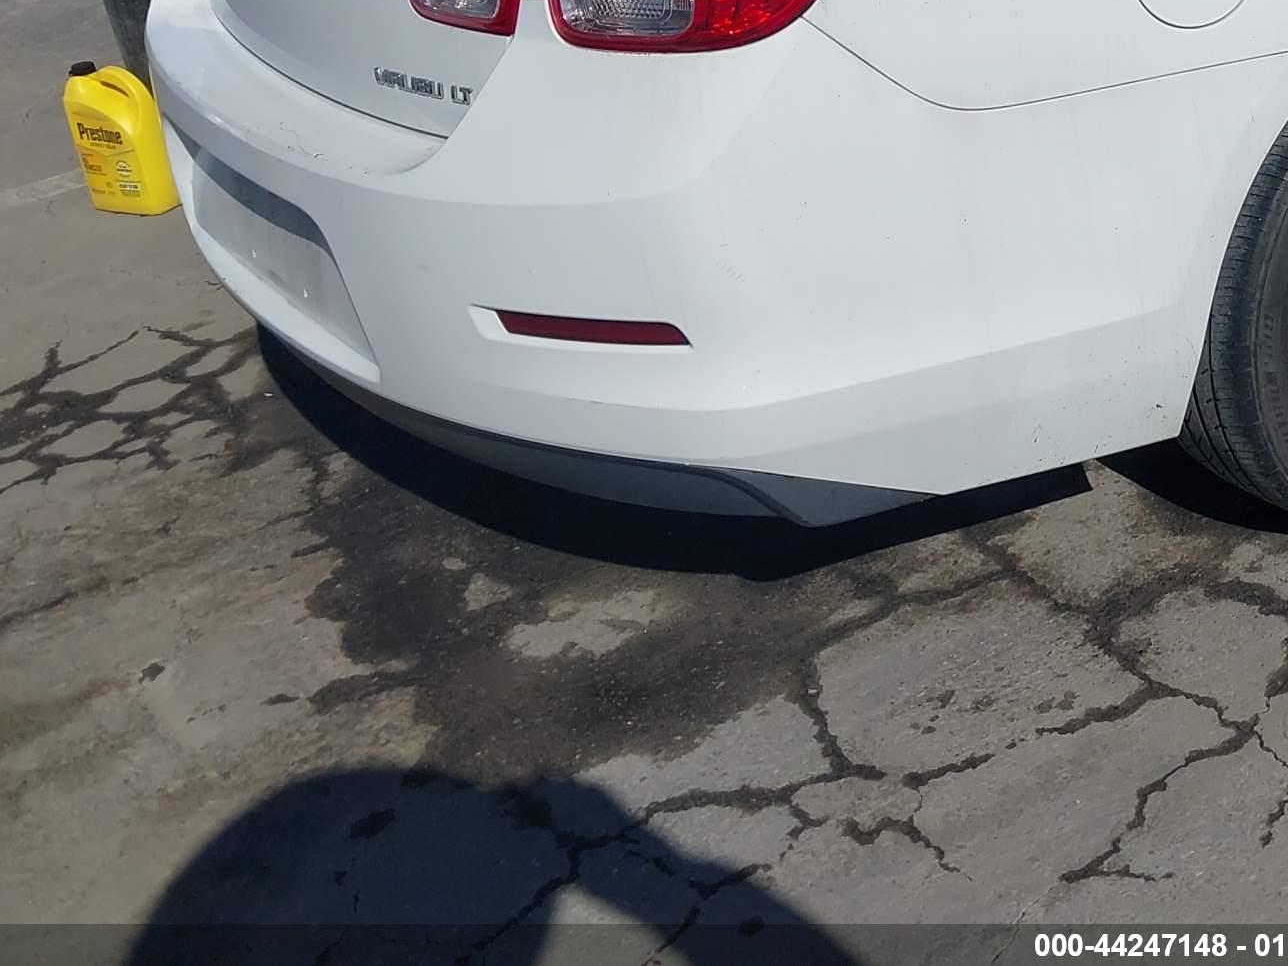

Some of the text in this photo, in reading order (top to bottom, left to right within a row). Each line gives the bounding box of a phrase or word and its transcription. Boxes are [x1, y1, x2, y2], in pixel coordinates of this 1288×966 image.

[374, 67, 474, 106] MALIBU LT
[76, 122, 123, 145] Prestone
